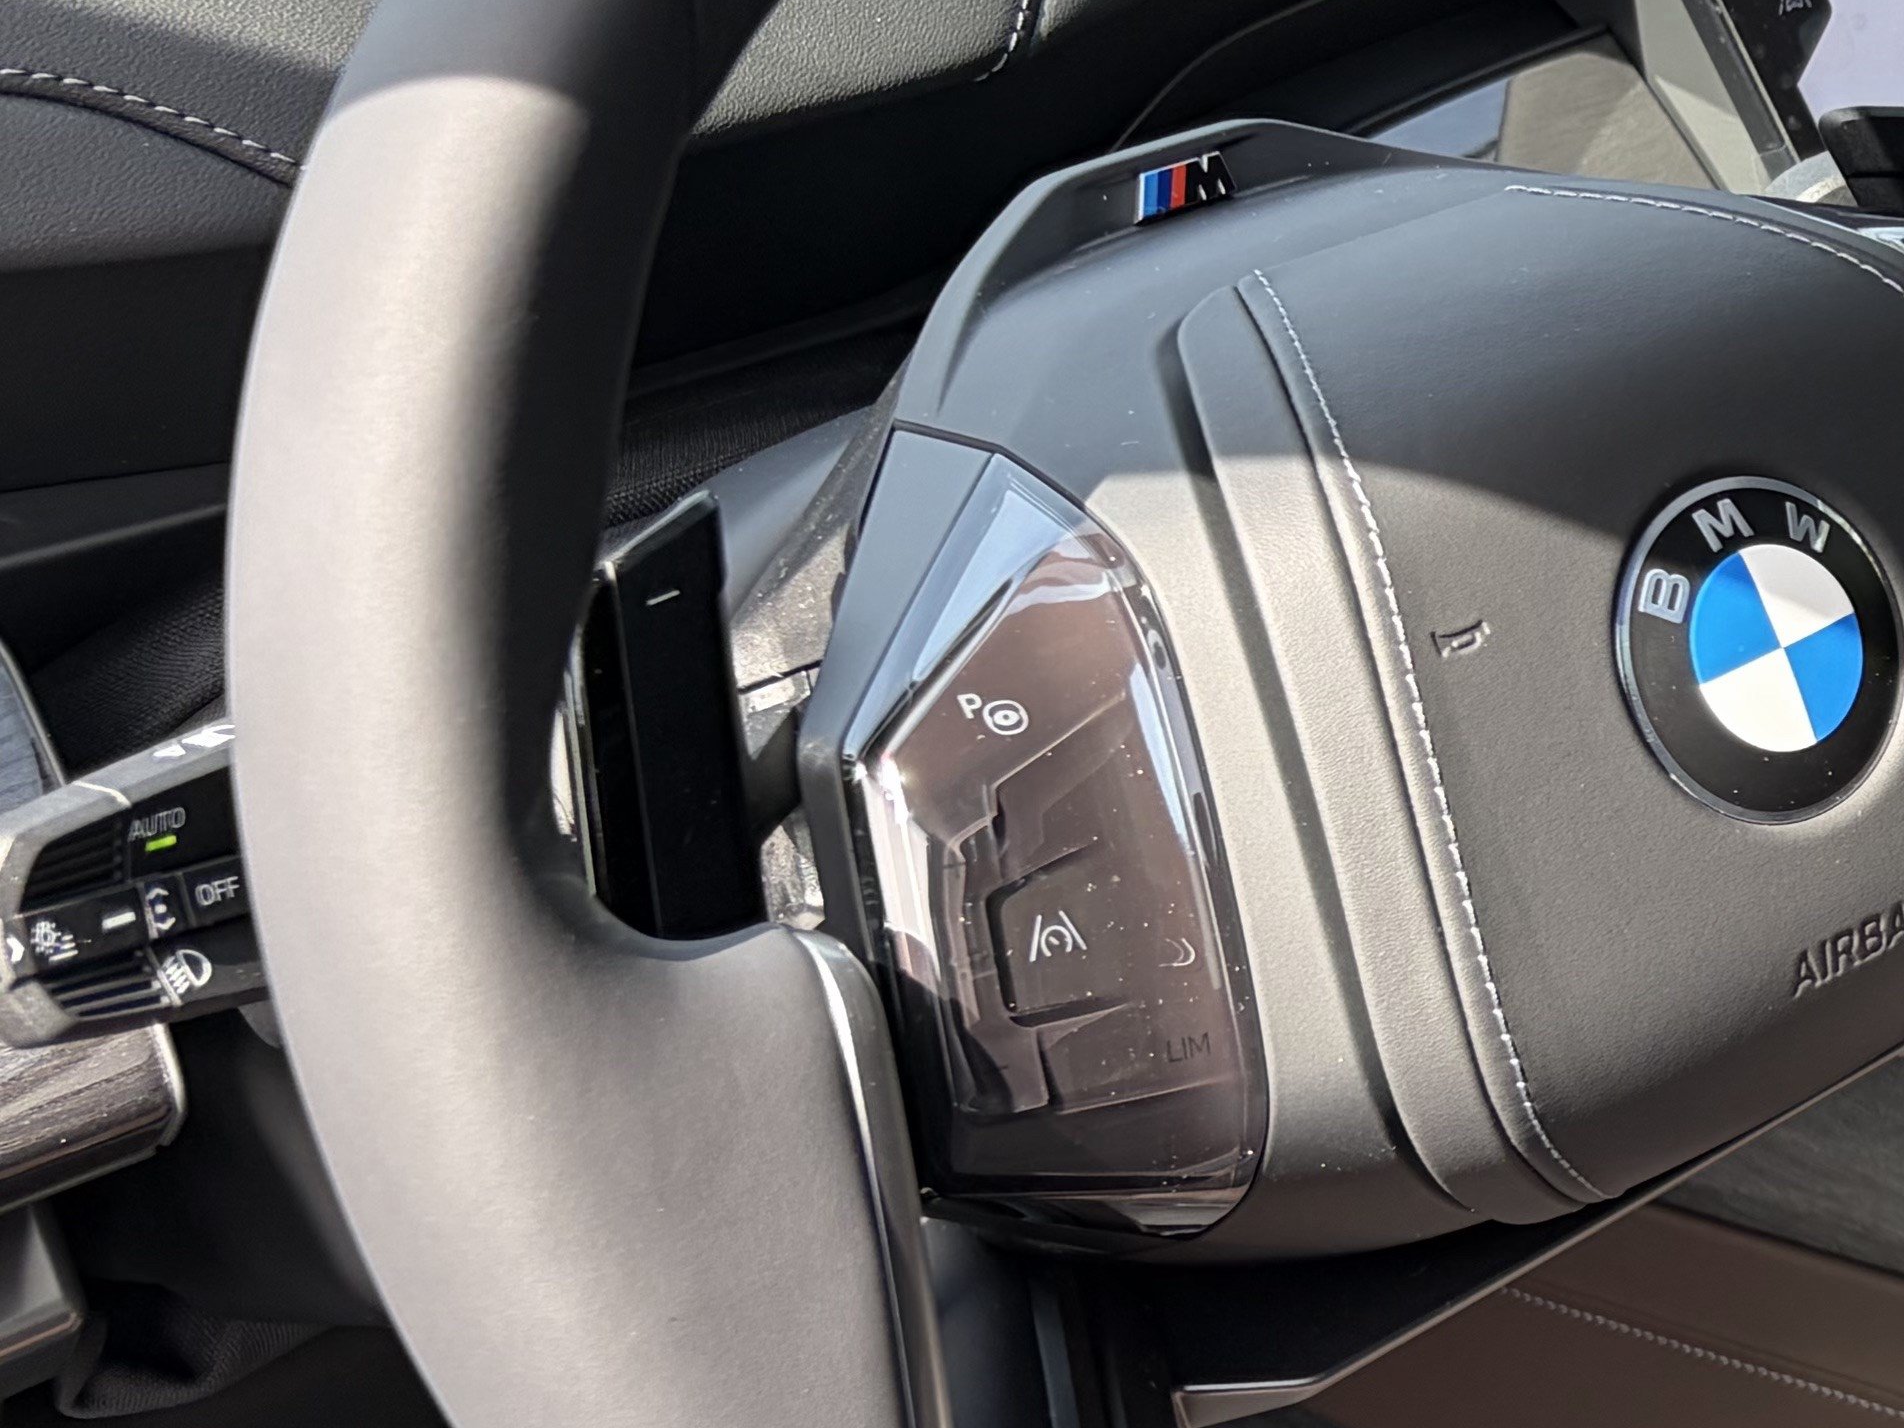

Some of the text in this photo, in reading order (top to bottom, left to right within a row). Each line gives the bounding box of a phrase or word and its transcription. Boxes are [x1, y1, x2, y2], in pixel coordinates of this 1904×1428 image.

[1638, 498, 1830, 624] BMW
[128, 807, 187, 842] AUTO
[195, 876, 240, 907] OFF
[1166, 1032, 1211, 1063] LIM
